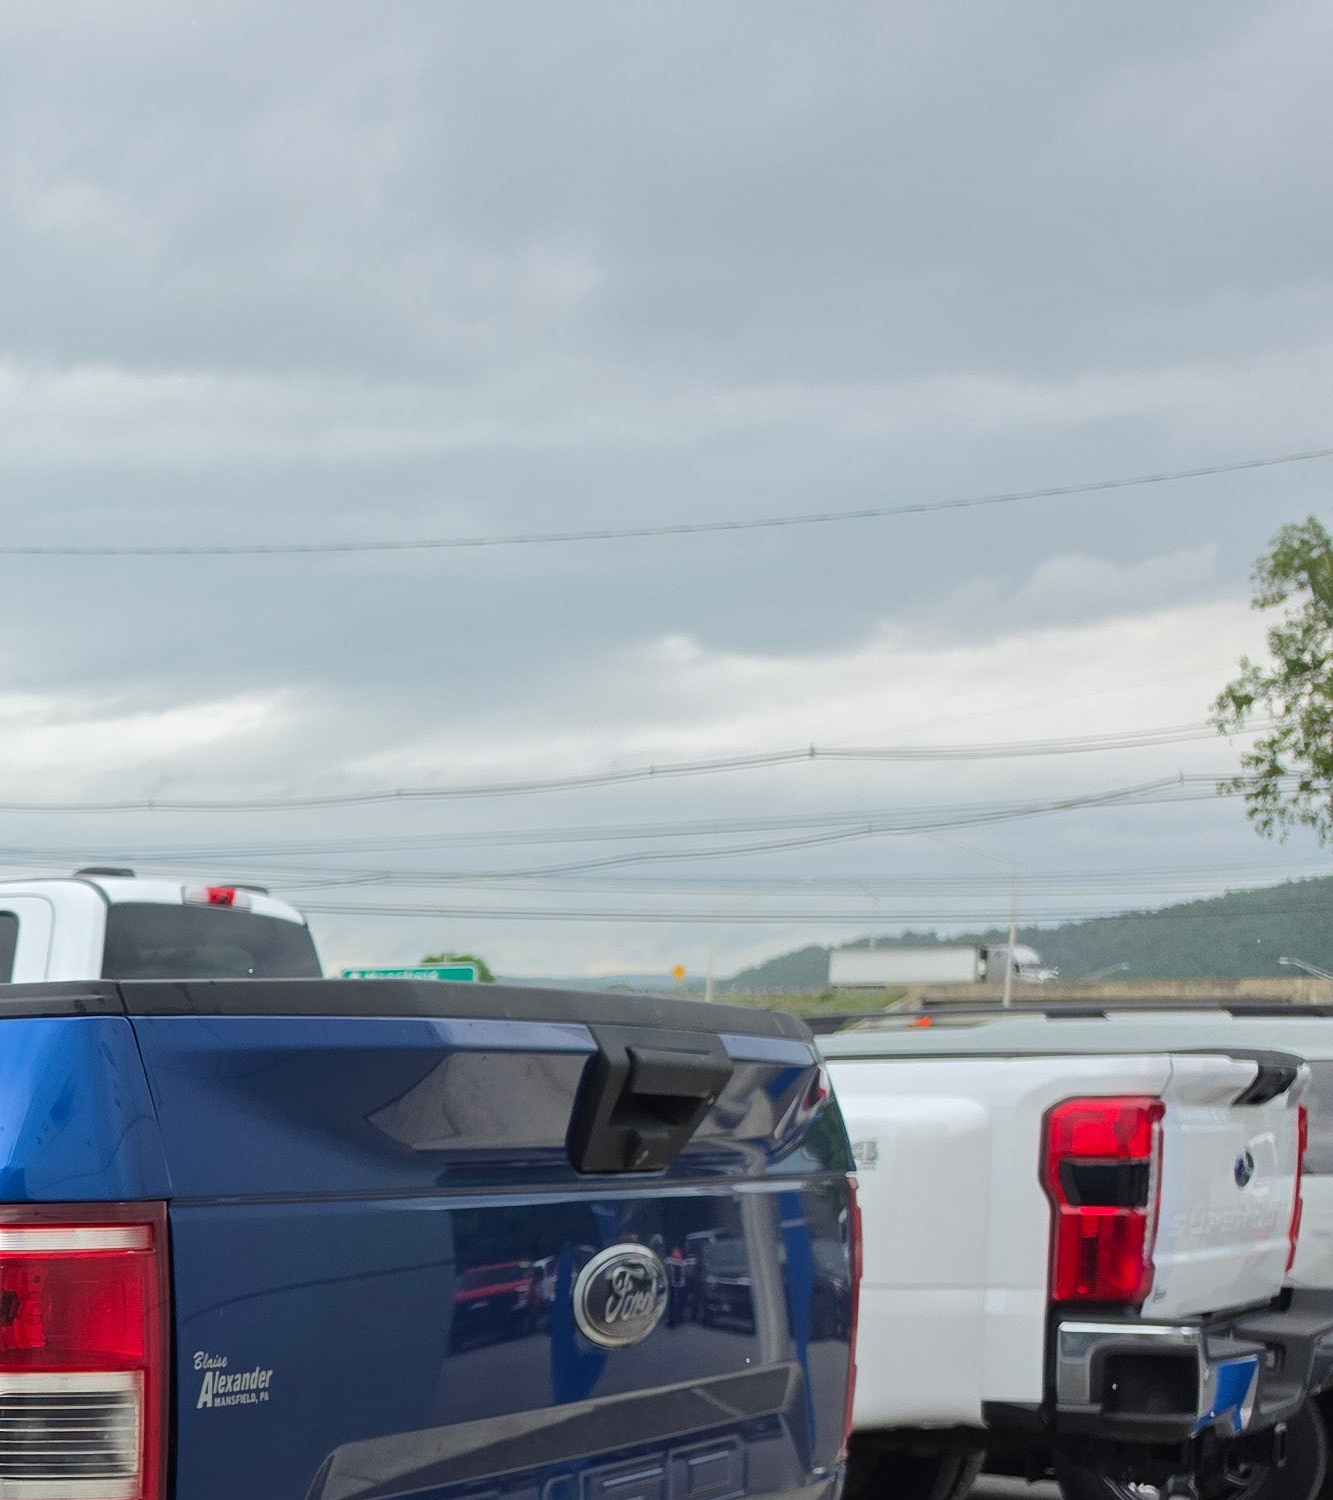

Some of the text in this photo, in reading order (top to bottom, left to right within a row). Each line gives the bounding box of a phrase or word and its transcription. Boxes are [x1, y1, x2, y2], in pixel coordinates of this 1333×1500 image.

[604, 1264, 658, 1324] Ford
[193, 1350, 228, 1371] Blaise
[196, 1366, 273, 1409] Alexander
[260, 1391, 269, 1402] PA
